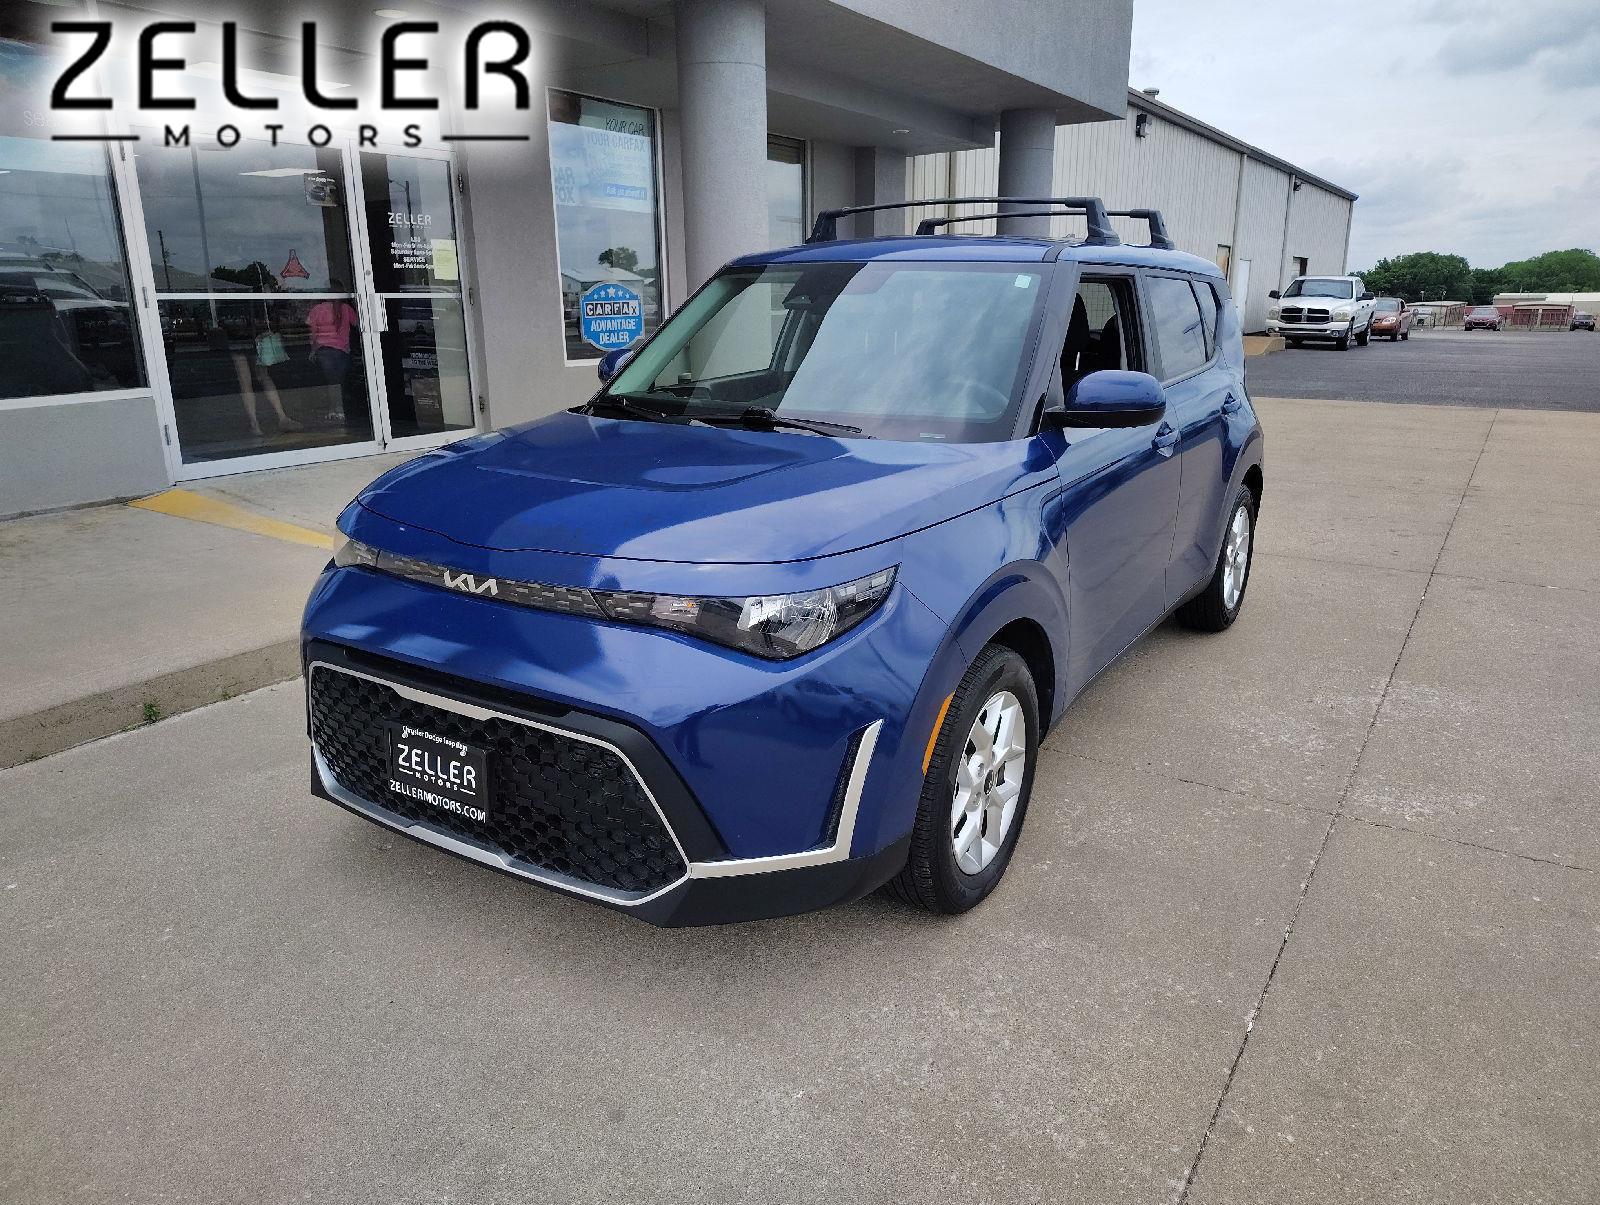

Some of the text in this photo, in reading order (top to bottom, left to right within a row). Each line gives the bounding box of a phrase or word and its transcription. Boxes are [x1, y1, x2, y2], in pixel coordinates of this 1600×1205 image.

[605, 117, 627, 134] YOUR
[586, 132, 646, 152] YOUR CARFAX
[388, 212, 432, 225] ZELLER
[586, 301, 638, 316] CARFAX
[591, 318, 636, 332] ADVANTAGE
[600, 332, 629, 345] DEALER
[444, 569, 498, 596] KIA
[425, 732, 442, 743] Dodge
[398, 744, 475, 788] ZELLER
[416, 772, 458, 790] MOTORS
[390, 779, 485, 823] ZELLERMOTORS.COM
